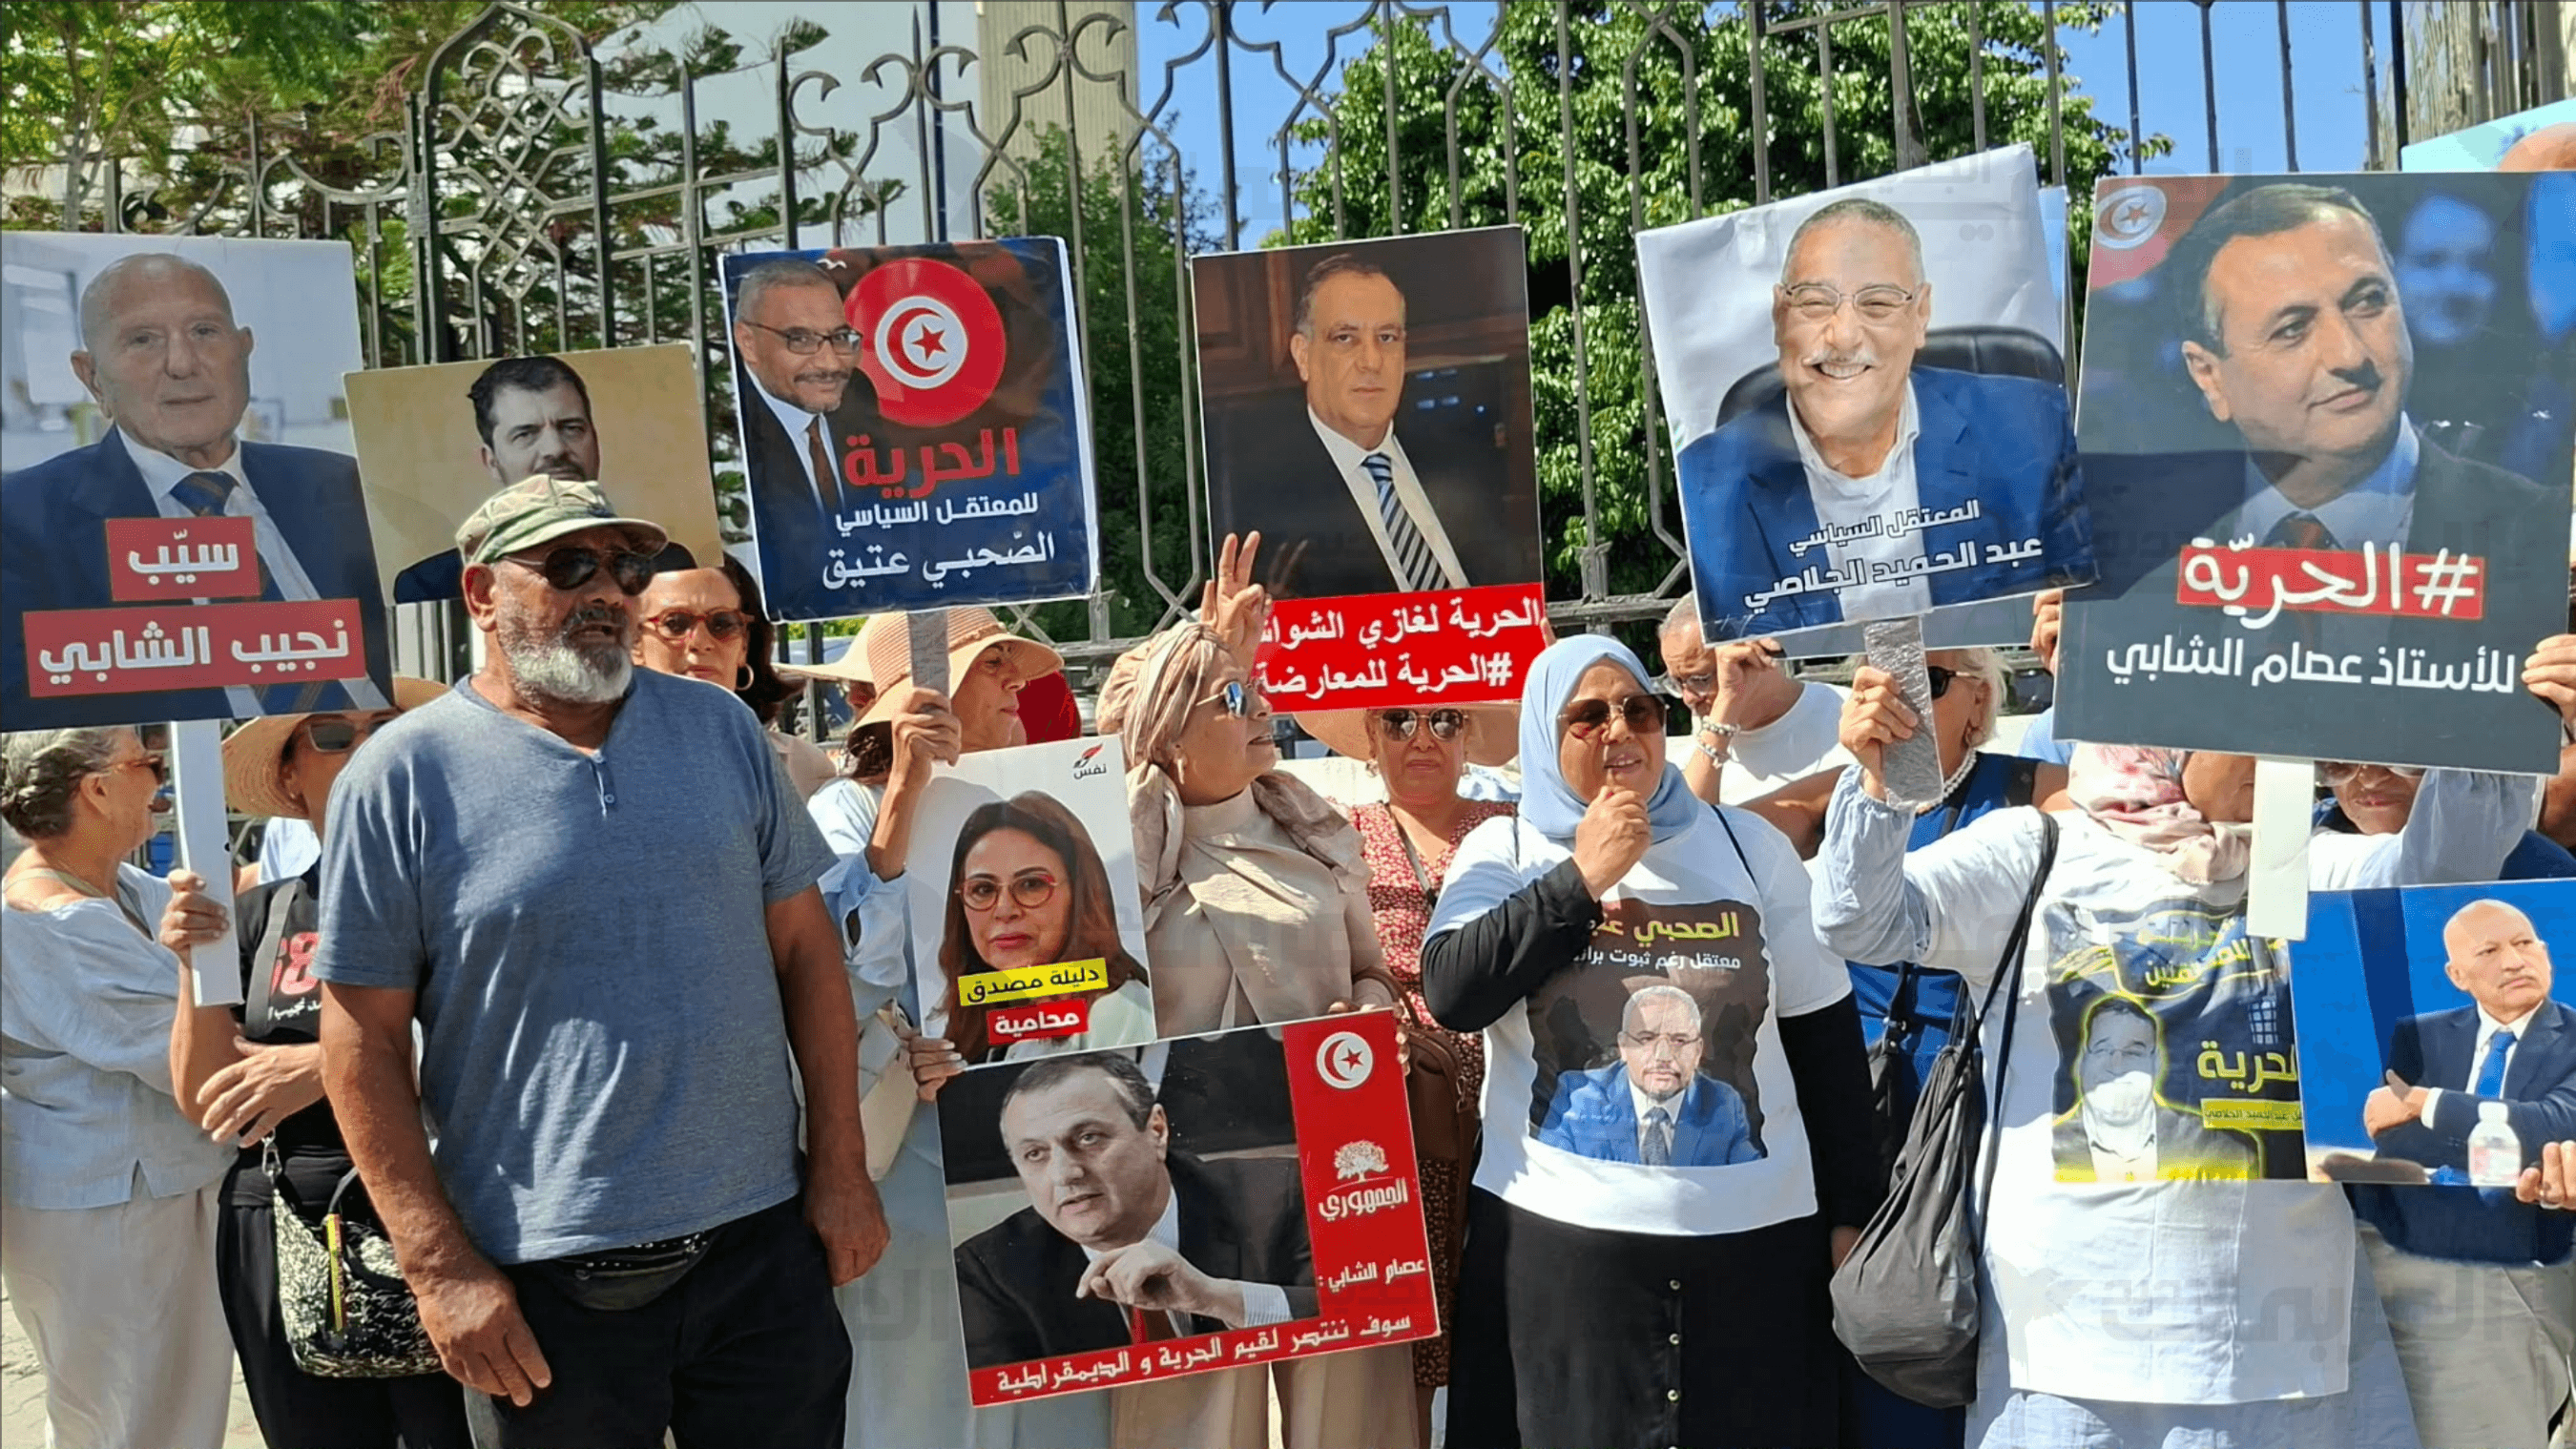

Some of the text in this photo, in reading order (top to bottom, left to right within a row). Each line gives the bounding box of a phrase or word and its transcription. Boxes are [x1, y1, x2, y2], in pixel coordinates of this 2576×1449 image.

[843, 428, 1021, 499] الحرية
[835, 501, 929, 537] السياسي
[1788, 499, 1981, 558] المعتقل السياسي
[822, 545, 910, 590] عتيق
[1743, 536, 2044, 614] عبد الحميد الجلاصي
[1359, 603, 1440, 650] لغازي
[1448, 596, 1541, 637] الحرية
[39, 618, 349, 685] نجيب الشابي
[2106, 633, 2517, 694] للأستاذ عصام الشابي
[1256, 658, 1388, 699] للمعارضة
[1072, 763, 1108, 780] نفس
[1633, 912, 1740, 947] الصحبي
[1610, 949, 1652, 967] ثبوت
[1655, 952, 1685, 970] رغم
[1689, 953, 1741, 969] معتقل
[966, 965, 1100, 1004] دليلة مصدق
[994, 1012, 1080, 1038] محامية
[1319, 1176, 1408, 1223] الجمهوري
[1330, 1261, 1378, 1294] الشابي
[1384, 1259, 1427, 1286] عصام
[998, 1313, 1412, 1395] سوف ننتصر لقيم الحرية و الديمقراطية
